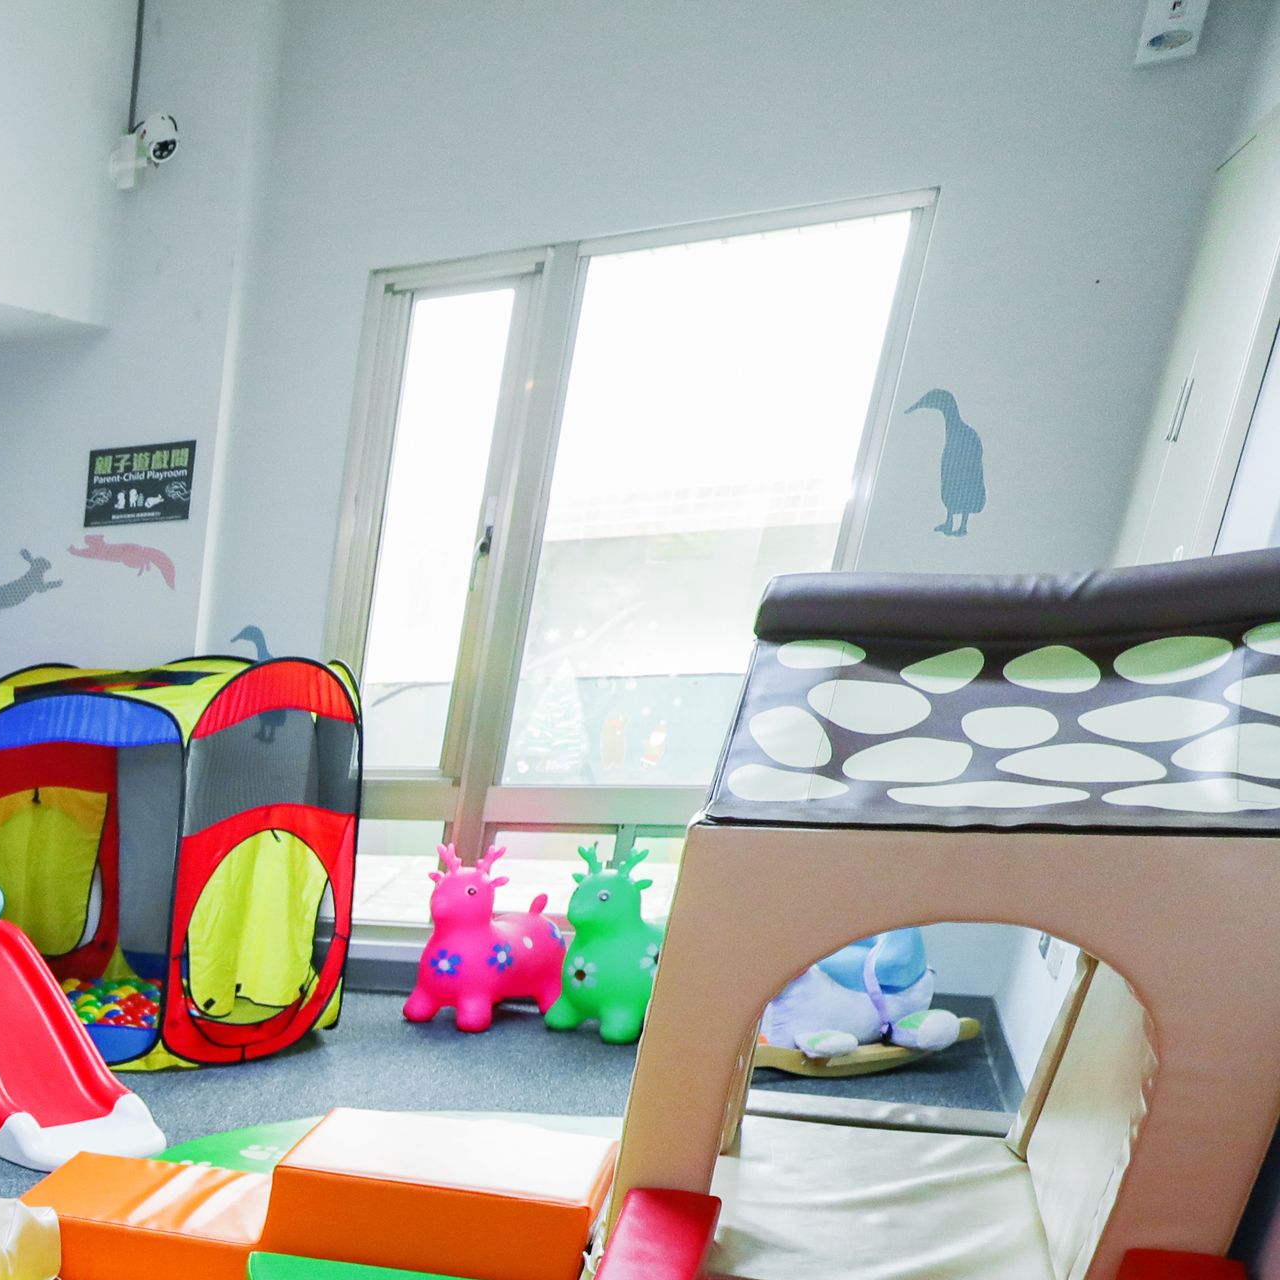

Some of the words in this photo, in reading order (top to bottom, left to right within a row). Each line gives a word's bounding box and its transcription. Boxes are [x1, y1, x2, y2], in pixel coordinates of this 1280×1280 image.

[94, 448, 189, 475] 親子遊戲間
[146, 469, 188, 480] Playroom
